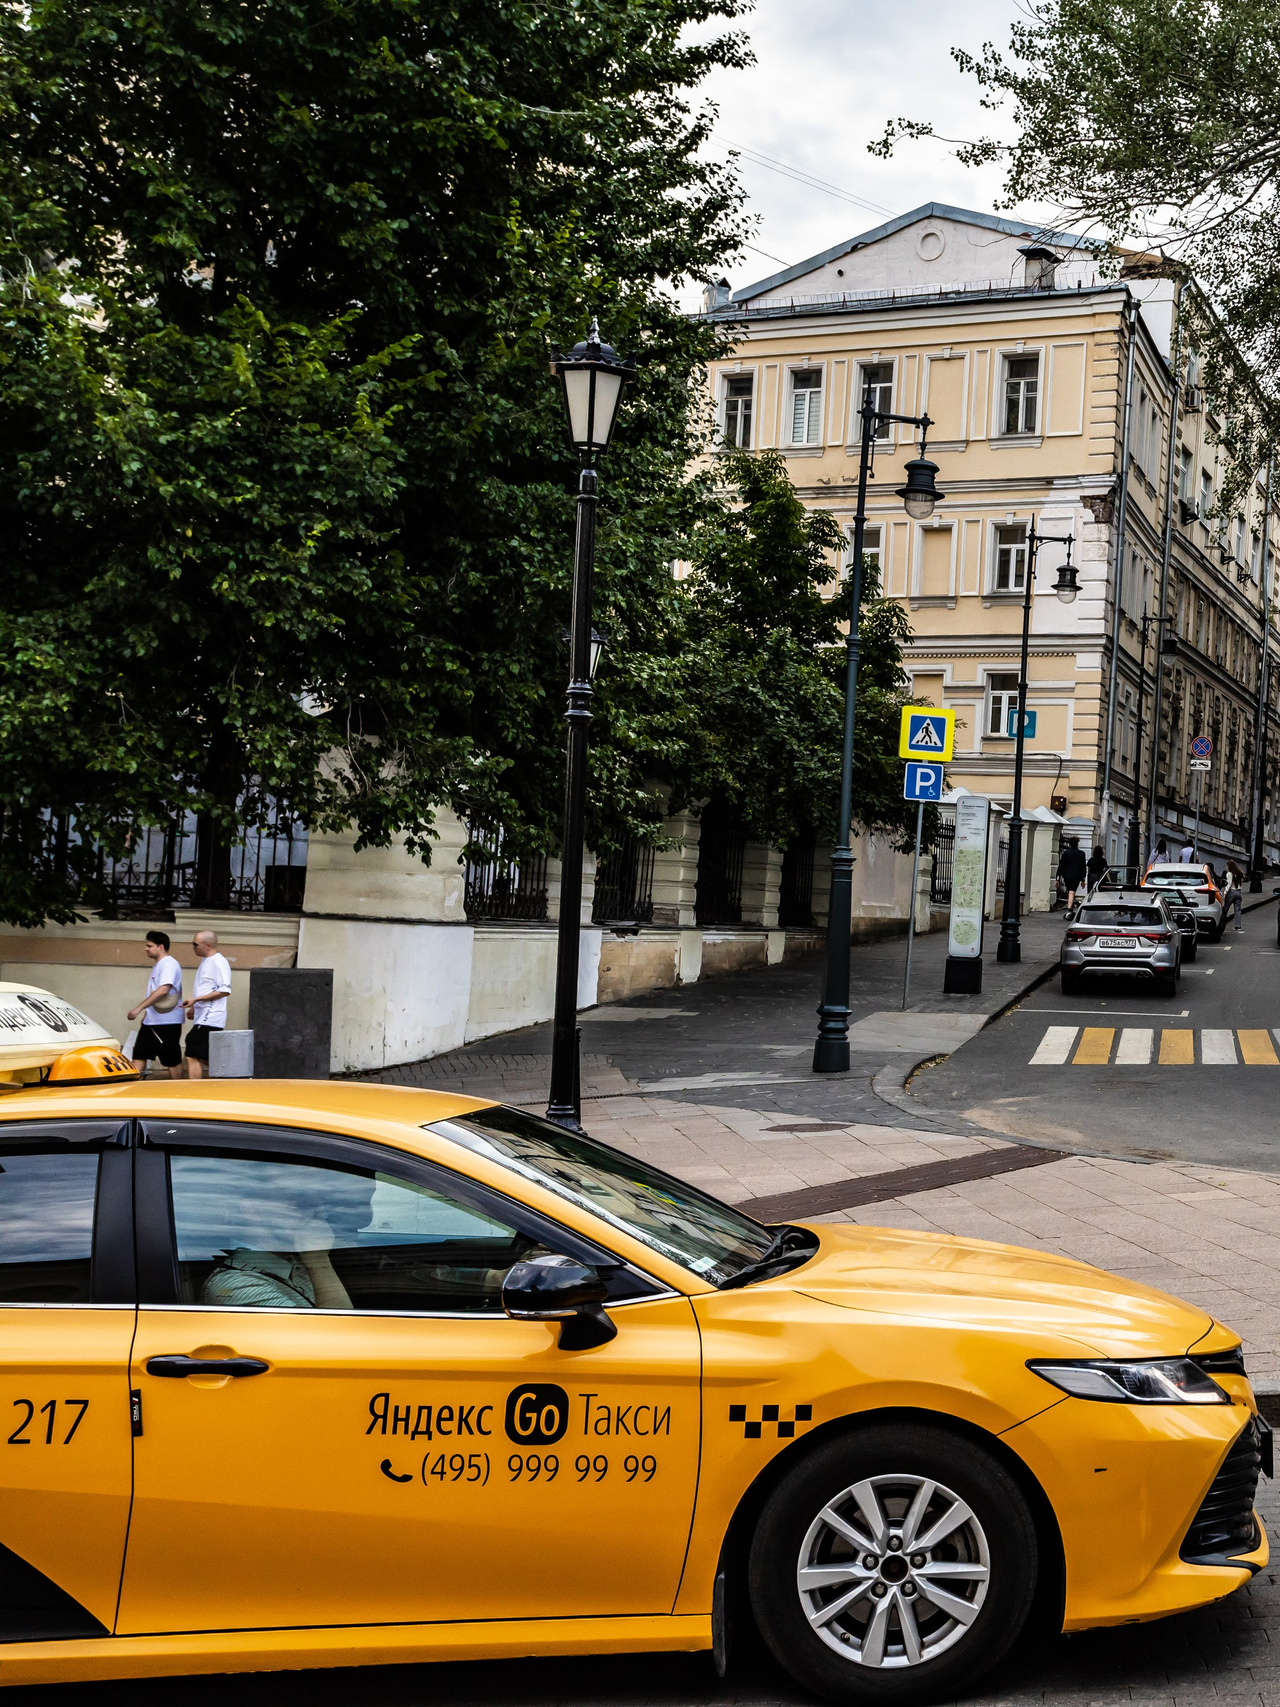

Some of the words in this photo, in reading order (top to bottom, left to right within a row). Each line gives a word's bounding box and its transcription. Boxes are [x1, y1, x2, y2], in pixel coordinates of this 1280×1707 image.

[915, 767, 936, 796] P
[7, 1398, 90, 1445] 217
[365, 1392, 494, 1441] Яндекс
[512, 1392, 560, 1436] Go
[578, 1393, 671, 1436] Такси
[421, 1452, 491, 1487] (495)
[507, 1454, 560, 1482] 999
[574, 1454, 609, 1482] 99
[623, 1454, 657, 1482] 99
